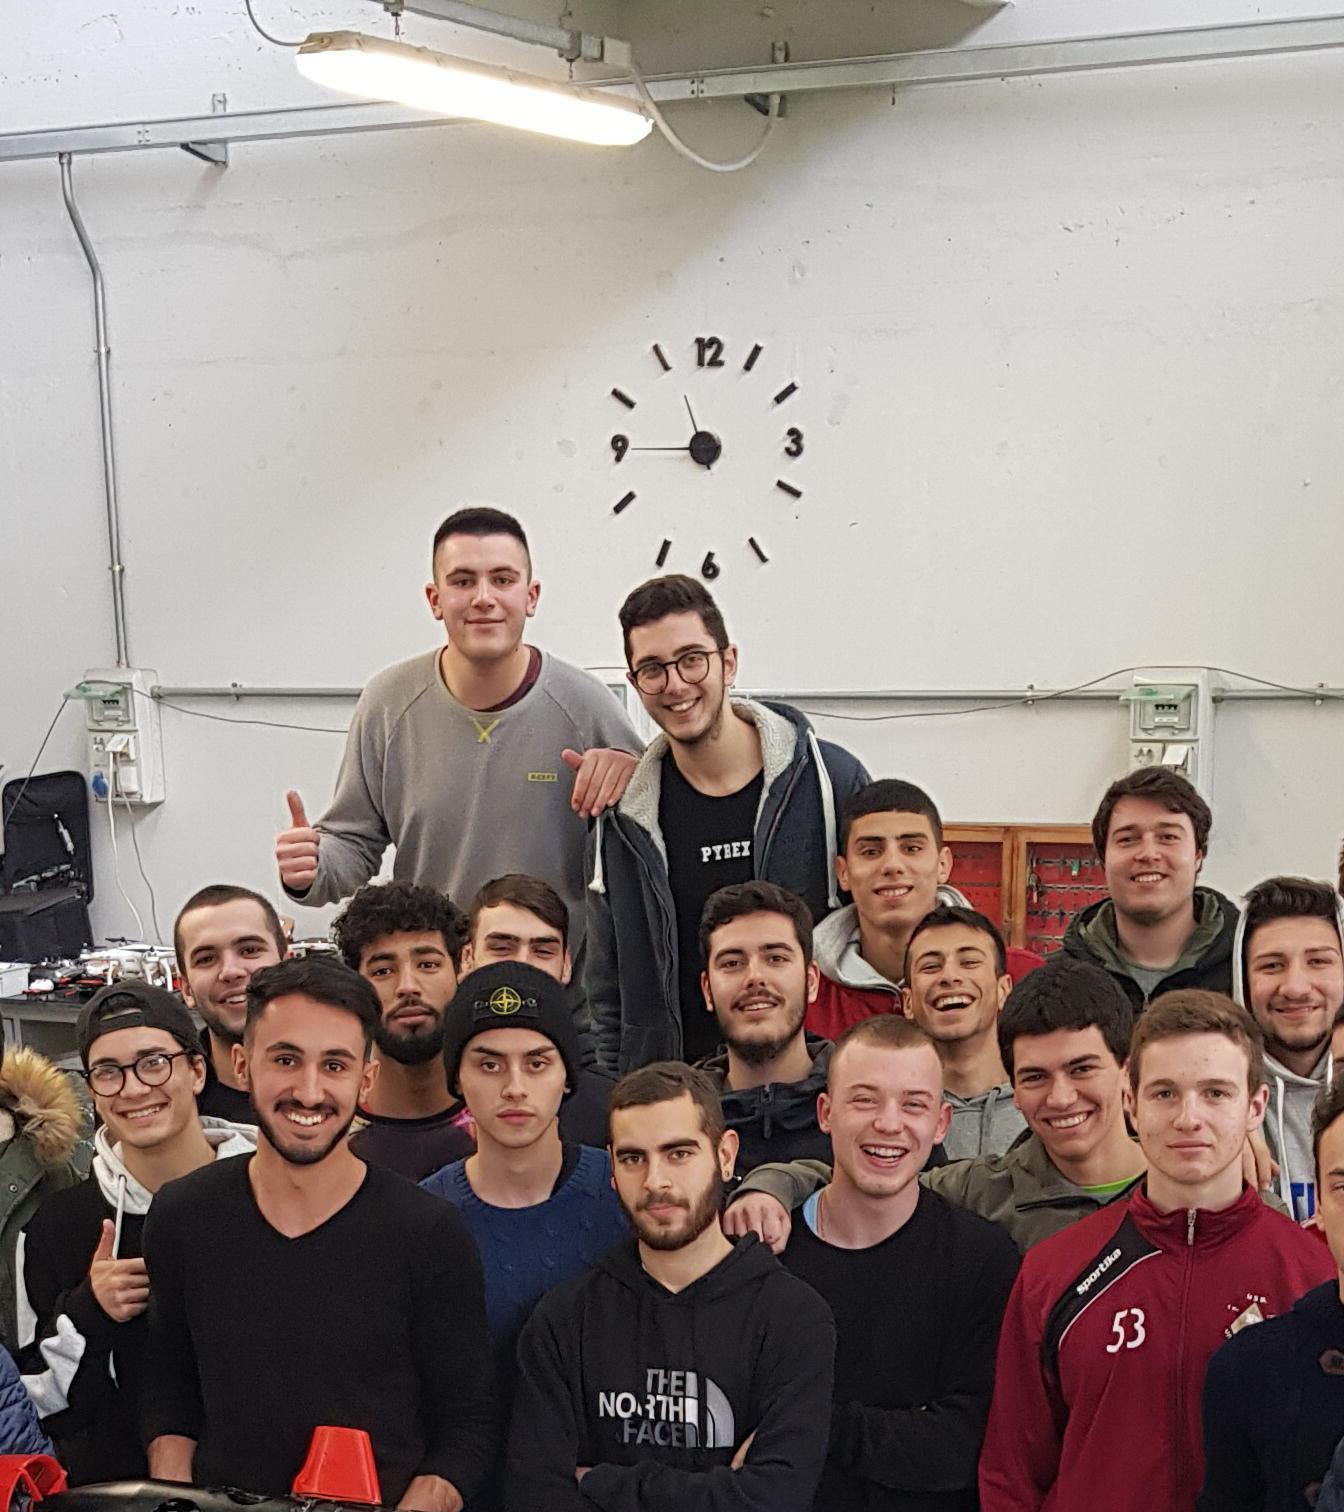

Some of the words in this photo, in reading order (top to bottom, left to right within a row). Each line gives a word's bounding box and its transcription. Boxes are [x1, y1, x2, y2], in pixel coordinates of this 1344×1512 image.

[694, 336, 725, 367] 12
[610, 433, 630, 463] 9
[784, 427, 805, 457] 3
[701, 551, 721, 580] 6
[701, 841, 751, 862] PYREX
[1076, 1248, 1122, 1295] sportika
[1106, 1308, 1146, 1353] 53
[646, 1368, 685, 1397] THE
[598, 1391, 684, 1422] NORTH
[622, 1420, 684, 1448] FACE
